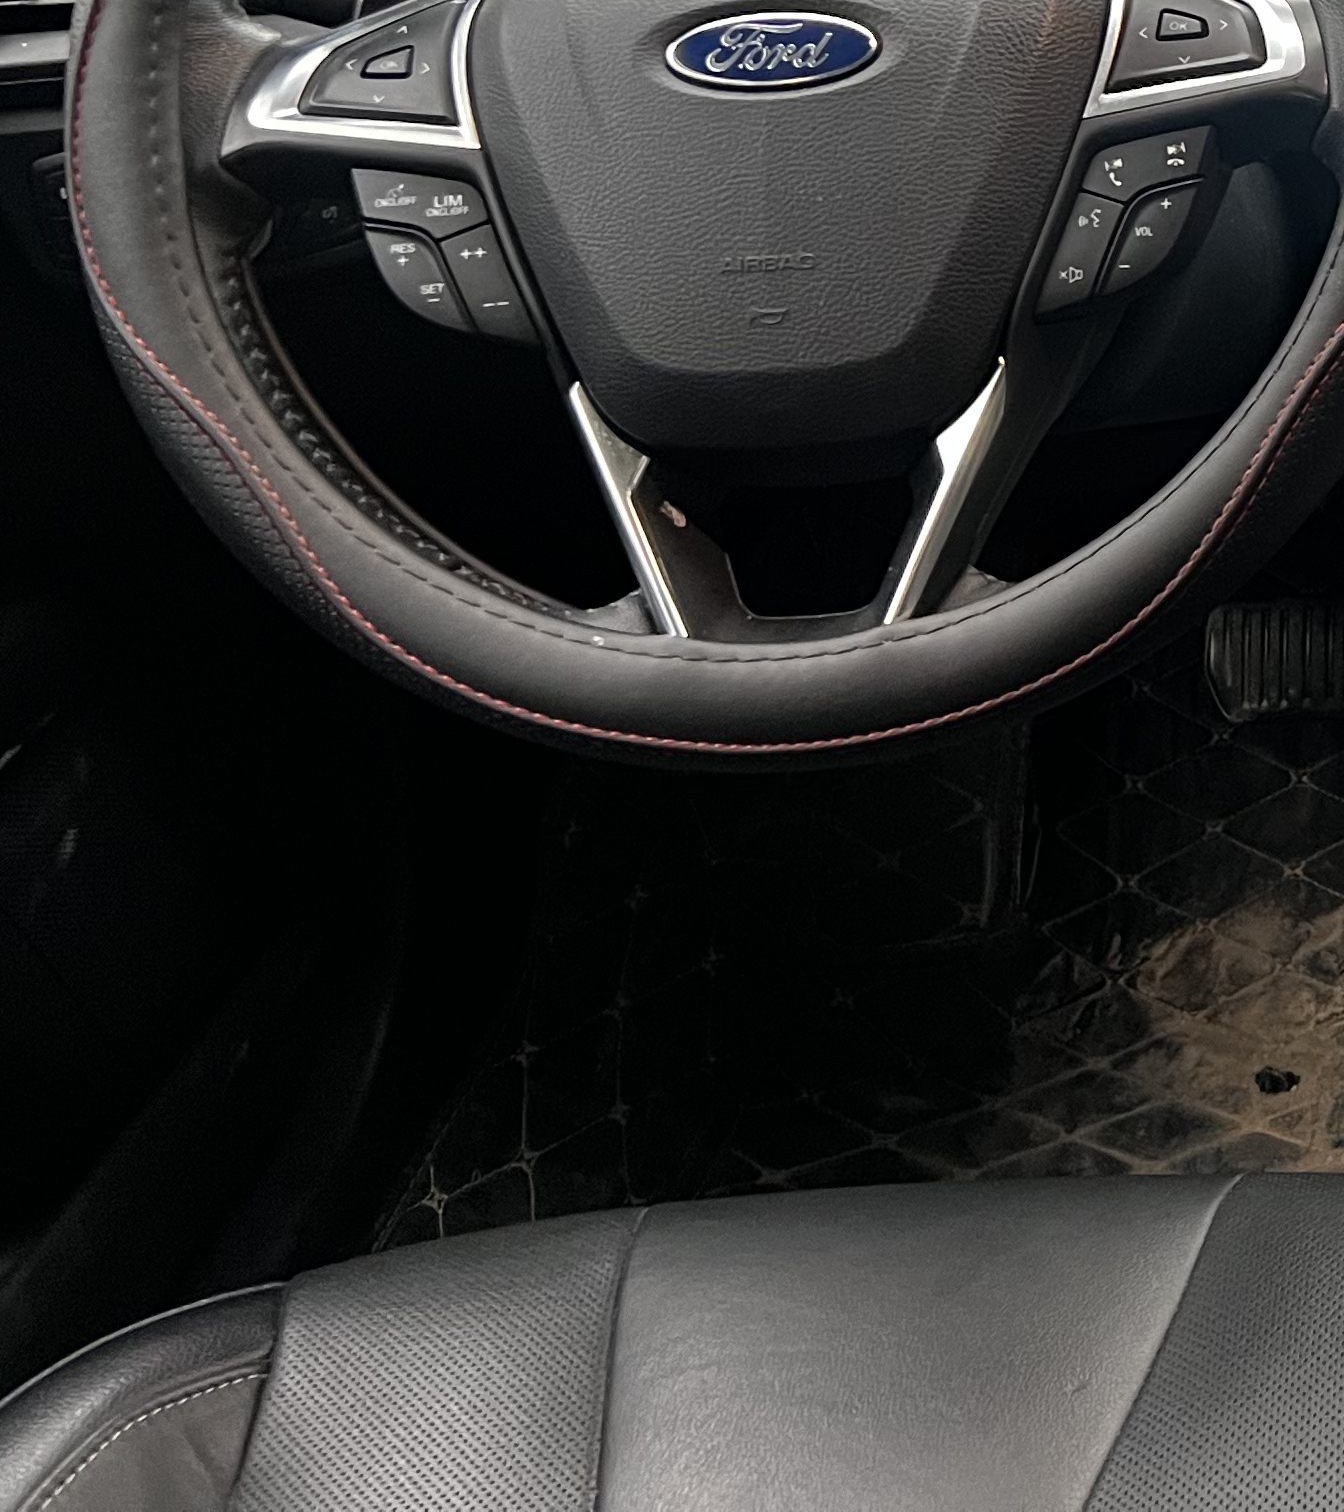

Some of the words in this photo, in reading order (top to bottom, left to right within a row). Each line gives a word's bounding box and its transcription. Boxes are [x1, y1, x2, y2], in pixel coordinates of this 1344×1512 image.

[1169, 20, 1188, 32] OK
[705, 22, 832, 73] Ford
[434, 195, 463, 208] LIM
[1134, 226, 1153, 237] VOL
[390, 242, 416, 254] RES
[420, 283, 444, 294] SET
